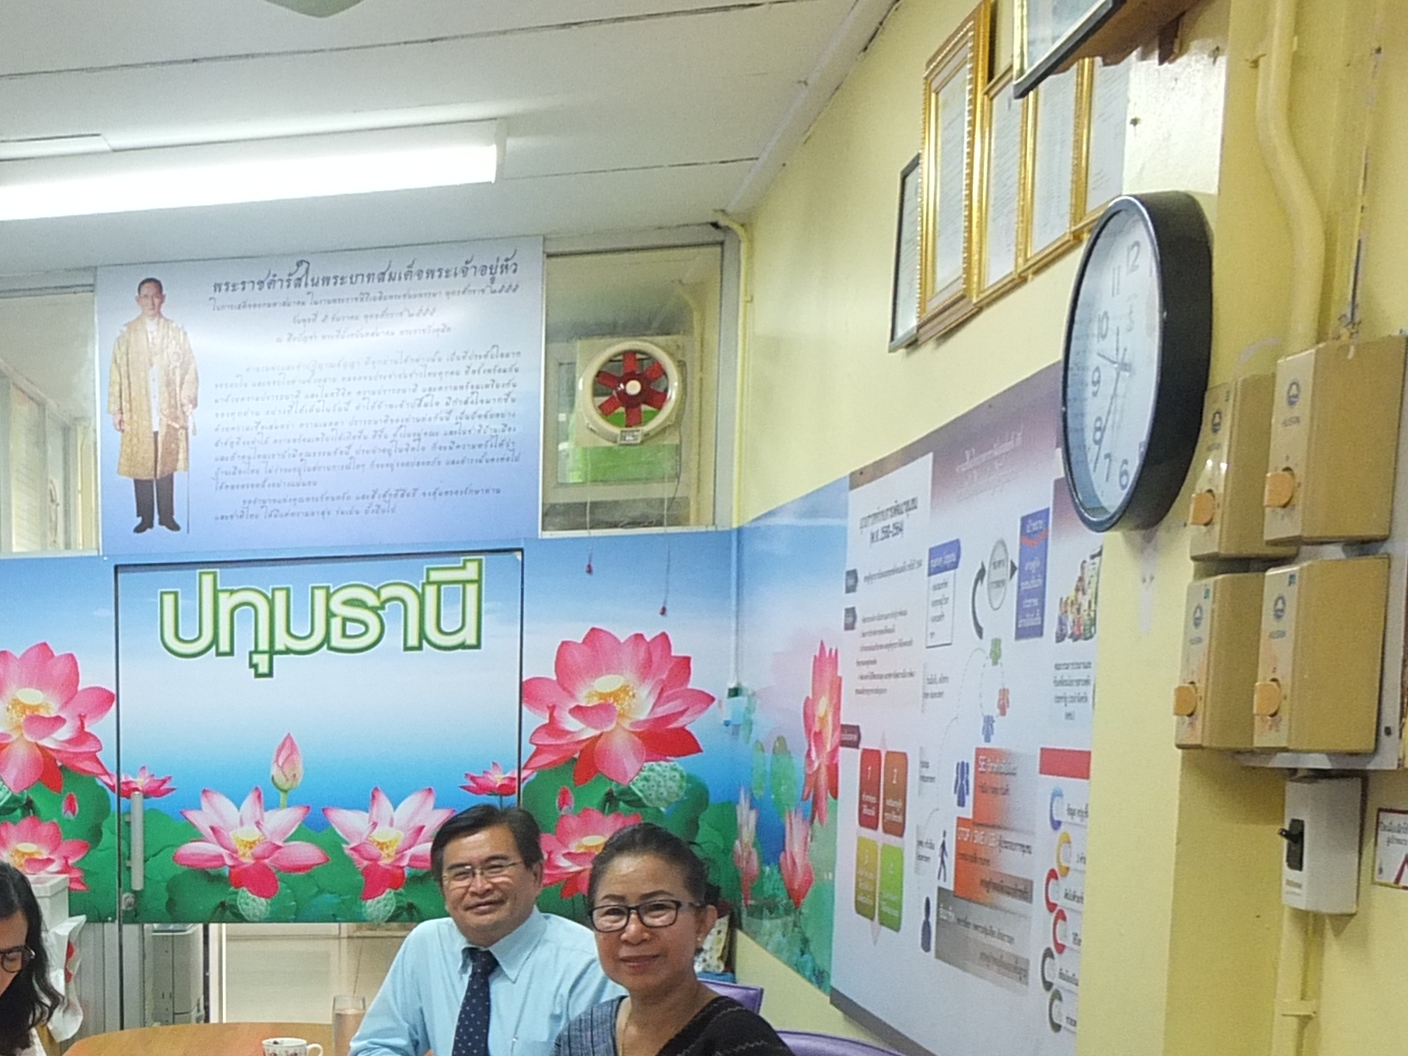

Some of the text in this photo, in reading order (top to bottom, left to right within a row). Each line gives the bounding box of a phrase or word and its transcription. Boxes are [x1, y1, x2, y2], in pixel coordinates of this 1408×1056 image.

[212, 249, 519, 293] พระราชดำรัสในพระบาทสมเด็จพระเจ้าอยู่หัว
[1126, 240, 1141, 277] 12
[1111, 265, 1121, 298] 11
[1096, 310, 1109, 343] 10
[1090, 365, 1101, 397] 9
[1092, 416, 1103, 446] 8
[1104, 452, 1113, 483] 7
[1118, 458, 1130, 491] 6
[158, 557, 485, 679] ปทุมธานี
